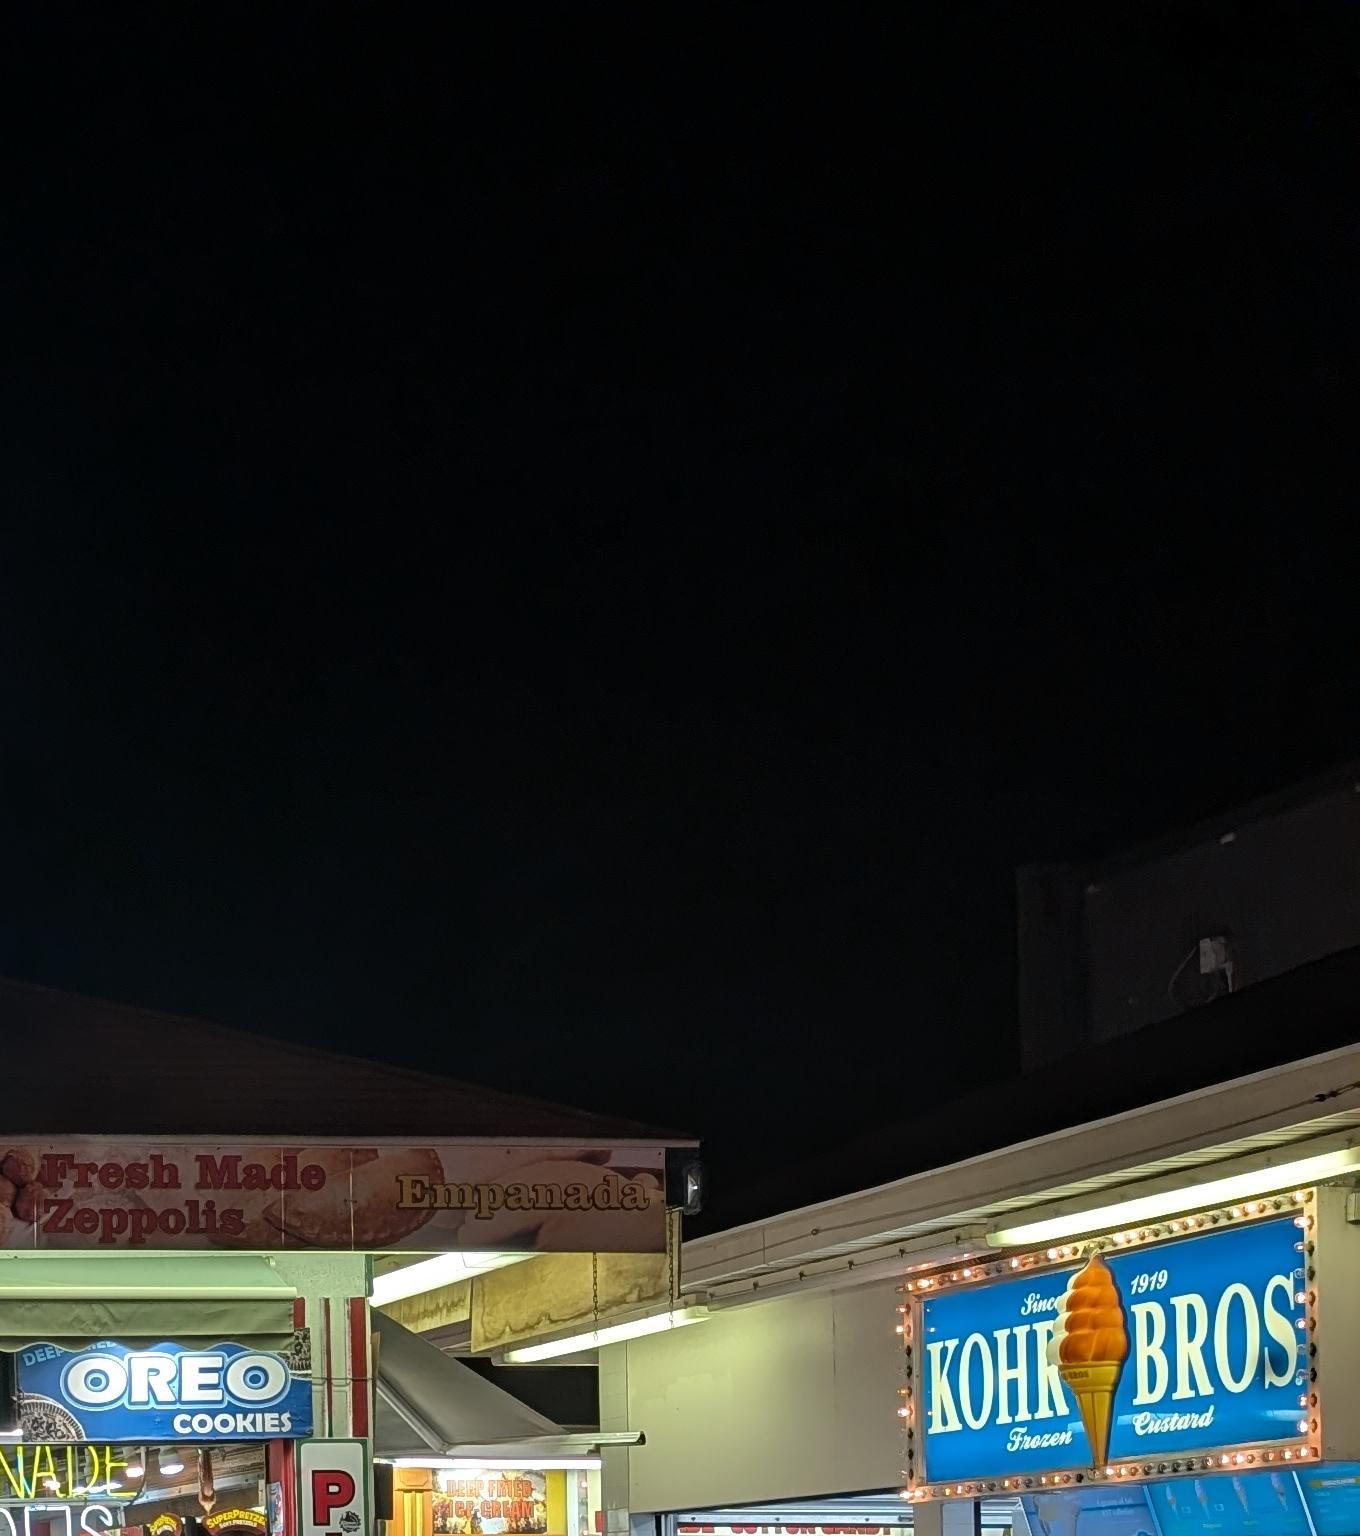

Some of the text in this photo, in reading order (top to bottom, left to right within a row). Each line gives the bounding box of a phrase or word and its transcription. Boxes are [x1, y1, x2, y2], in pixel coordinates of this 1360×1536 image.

[38, 1153, 326, 1193] Fresh Made
[396, 1172, 650, 1218] Empanada
[38, 1199, 245, 1247] Zeppolis
[1130, 1268, 1169, 1295] 1919
[1129, 1271, 1298, 1407] BROS
[65, 1352, 289, 1406] OREO
[172, 1409, 293, 1434] COOKIES
[1006, 1404, 1215, 1453] Frozen Custard
[446, 1479, 534, 1498] DEEP FRIED
